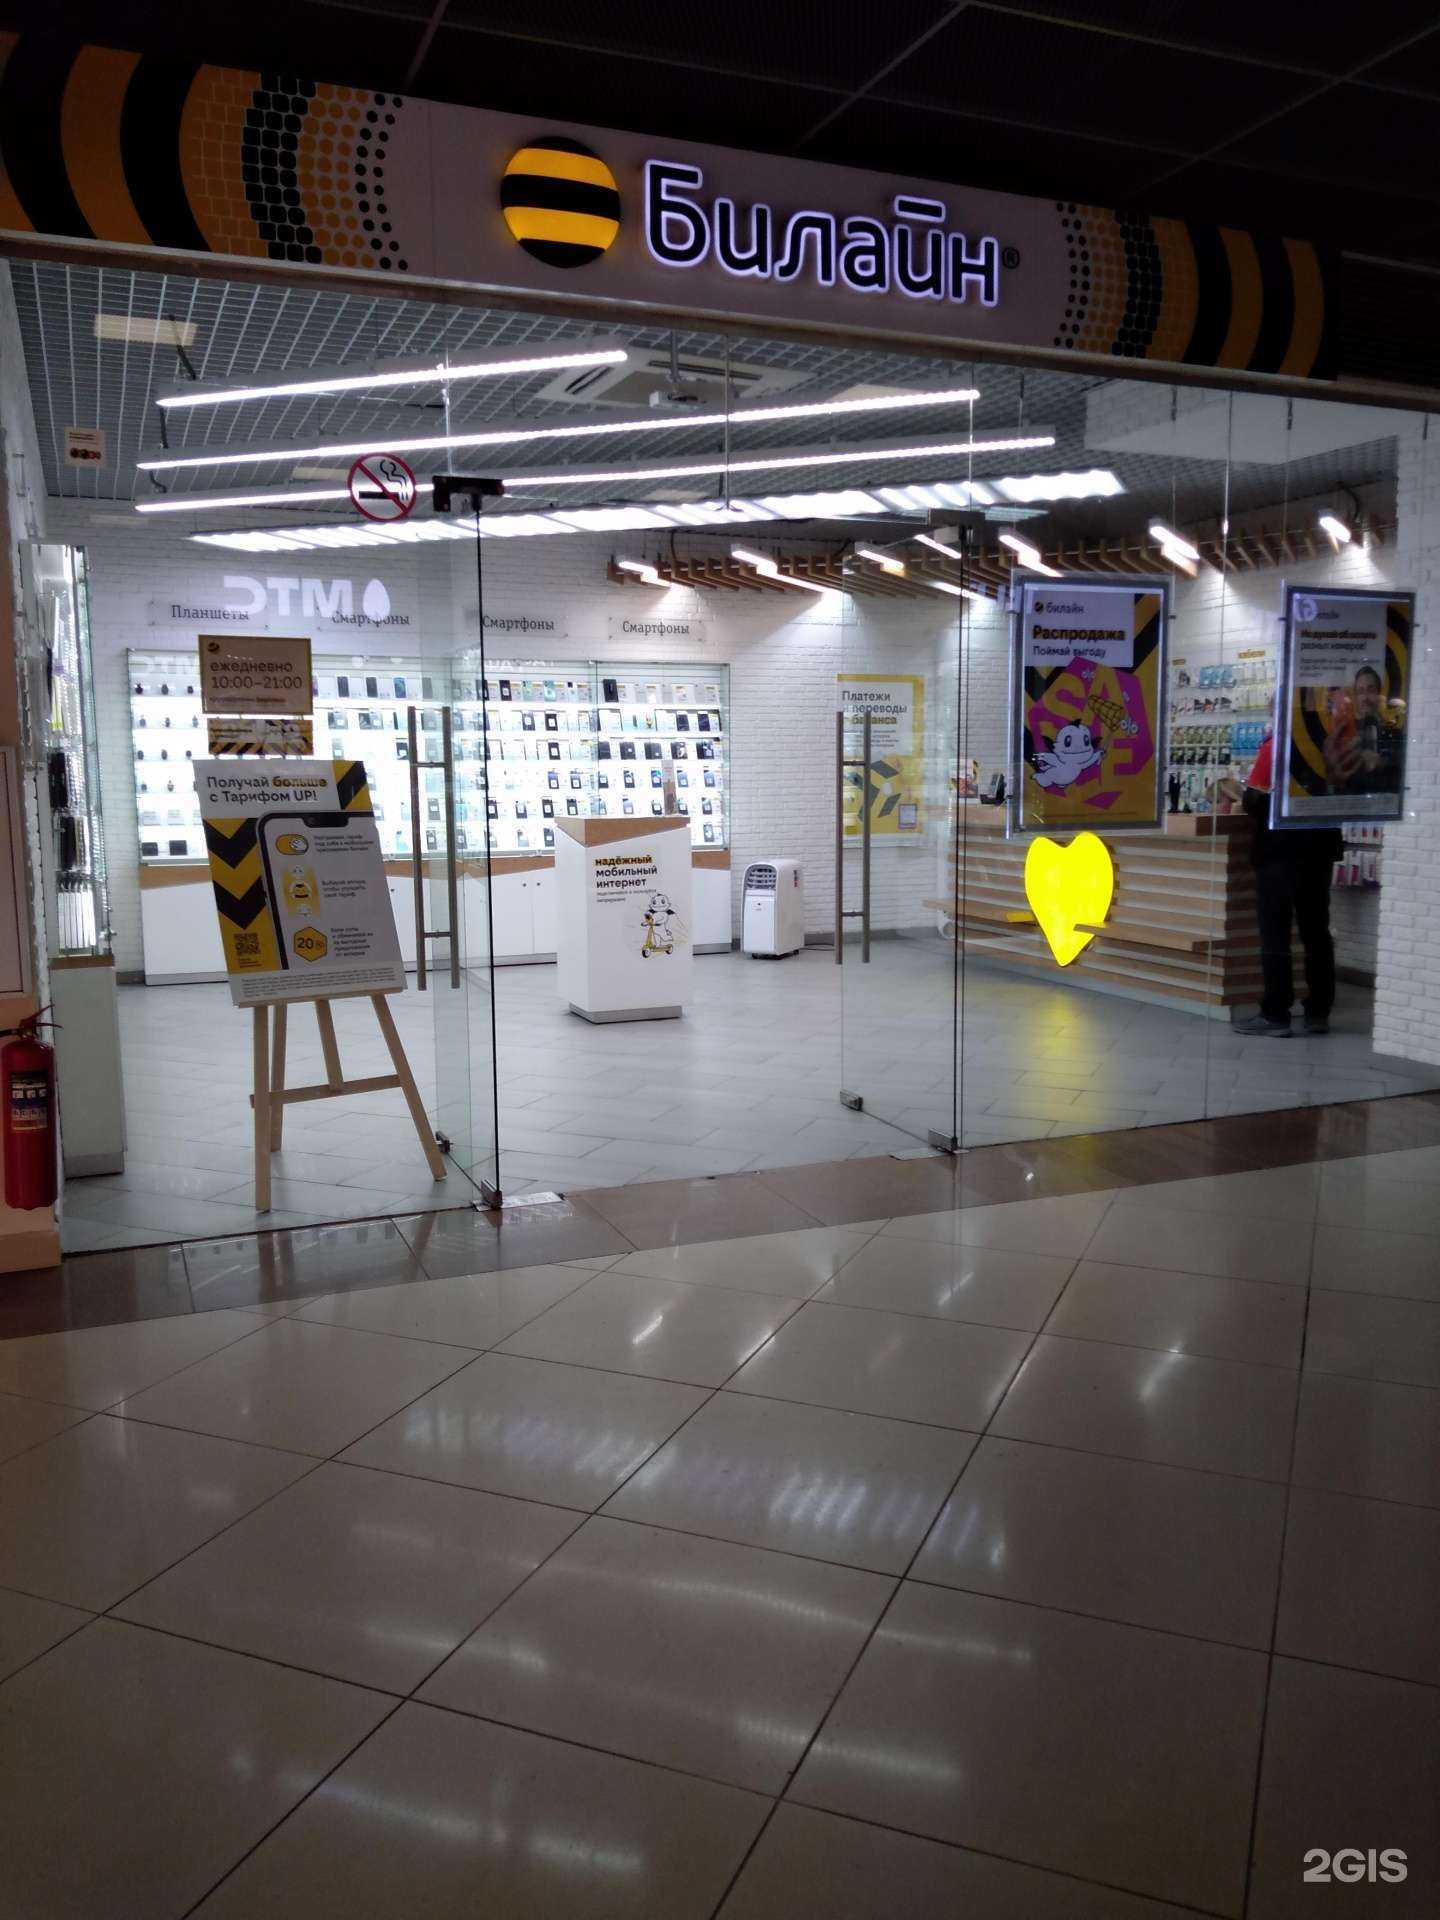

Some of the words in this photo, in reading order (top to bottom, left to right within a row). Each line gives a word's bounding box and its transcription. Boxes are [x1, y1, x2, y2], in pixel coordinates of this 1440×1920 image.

[171, 605, 249, 621] Планшеты
[482, 616, 555, 632] Смартфоны
[622, 620, 690, 635] Смартфоны
[1033, 625, 1126, 643] Распродажа
[1033, 645, 1071, 657] Поймай
[1073, 647, 1107, 660] выгоду
[210, 661, 294, 674] ежедневно
[842, 691, 891, 703] Платежи
[852, 703, 908, 715] переводы
[851, 713, 898, 725] баанса
[207, 775, 270, 791] Получай
[272, 776, 329, 789] больше
[209, 793, 219, 803] с
[222, 790, 291, 806] Тарифом
[293, 789, 318, 802] UP!
[595, 854, 653, 867] надёжный
[596, 865, 658, 878] мобильный
[596, 878, 647, 890] интернет
